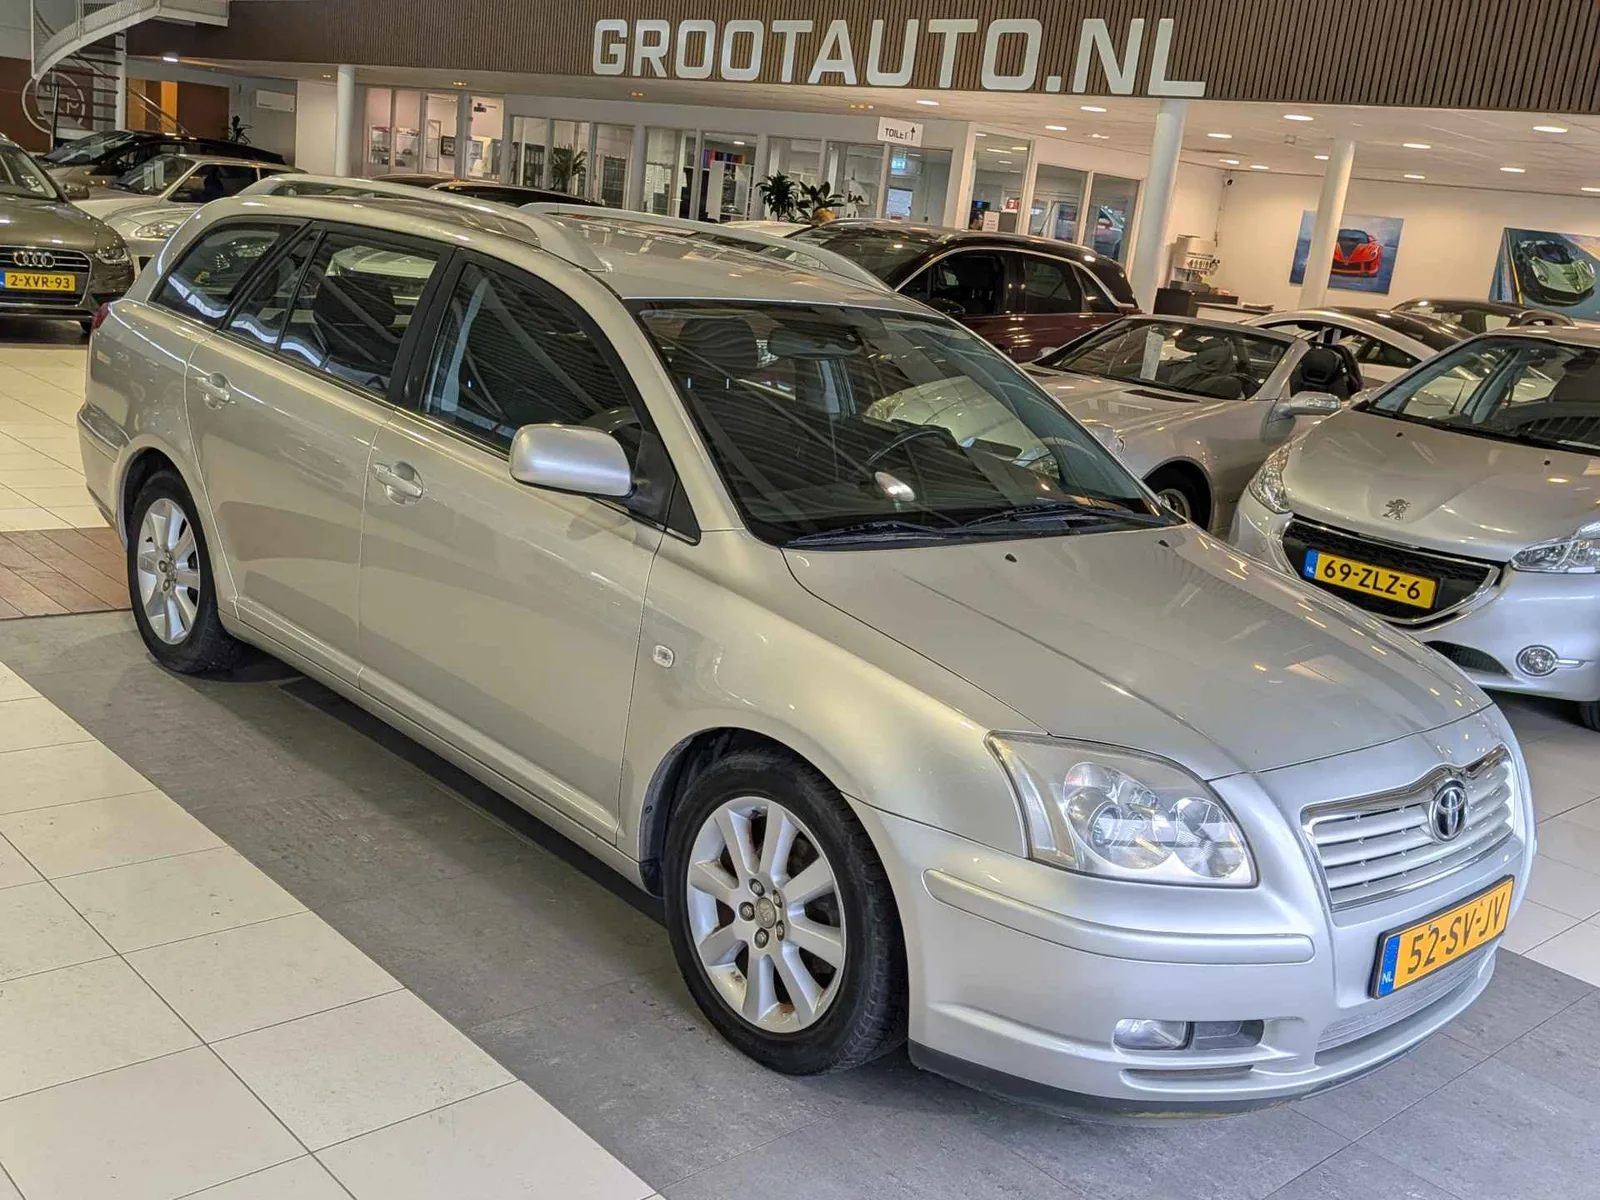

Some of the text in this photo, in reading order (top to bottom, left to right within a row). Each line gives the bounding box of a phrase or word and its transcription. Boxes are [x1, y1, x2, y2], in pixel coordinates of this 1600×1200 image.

[592, 18, 1207, 97] GROOTAUTO.NL
[885, 127, 909, 140] TOILET
[10, 274, 70, 289] 2-XVR-93
[1306, 566, 1315, 574] NL
[1323, 559, 1421, 601] 69-ZLZ-6
[1407, 891, 1506, 975] 52-SV-JV
[1381, 970, 1393, 985] NL
